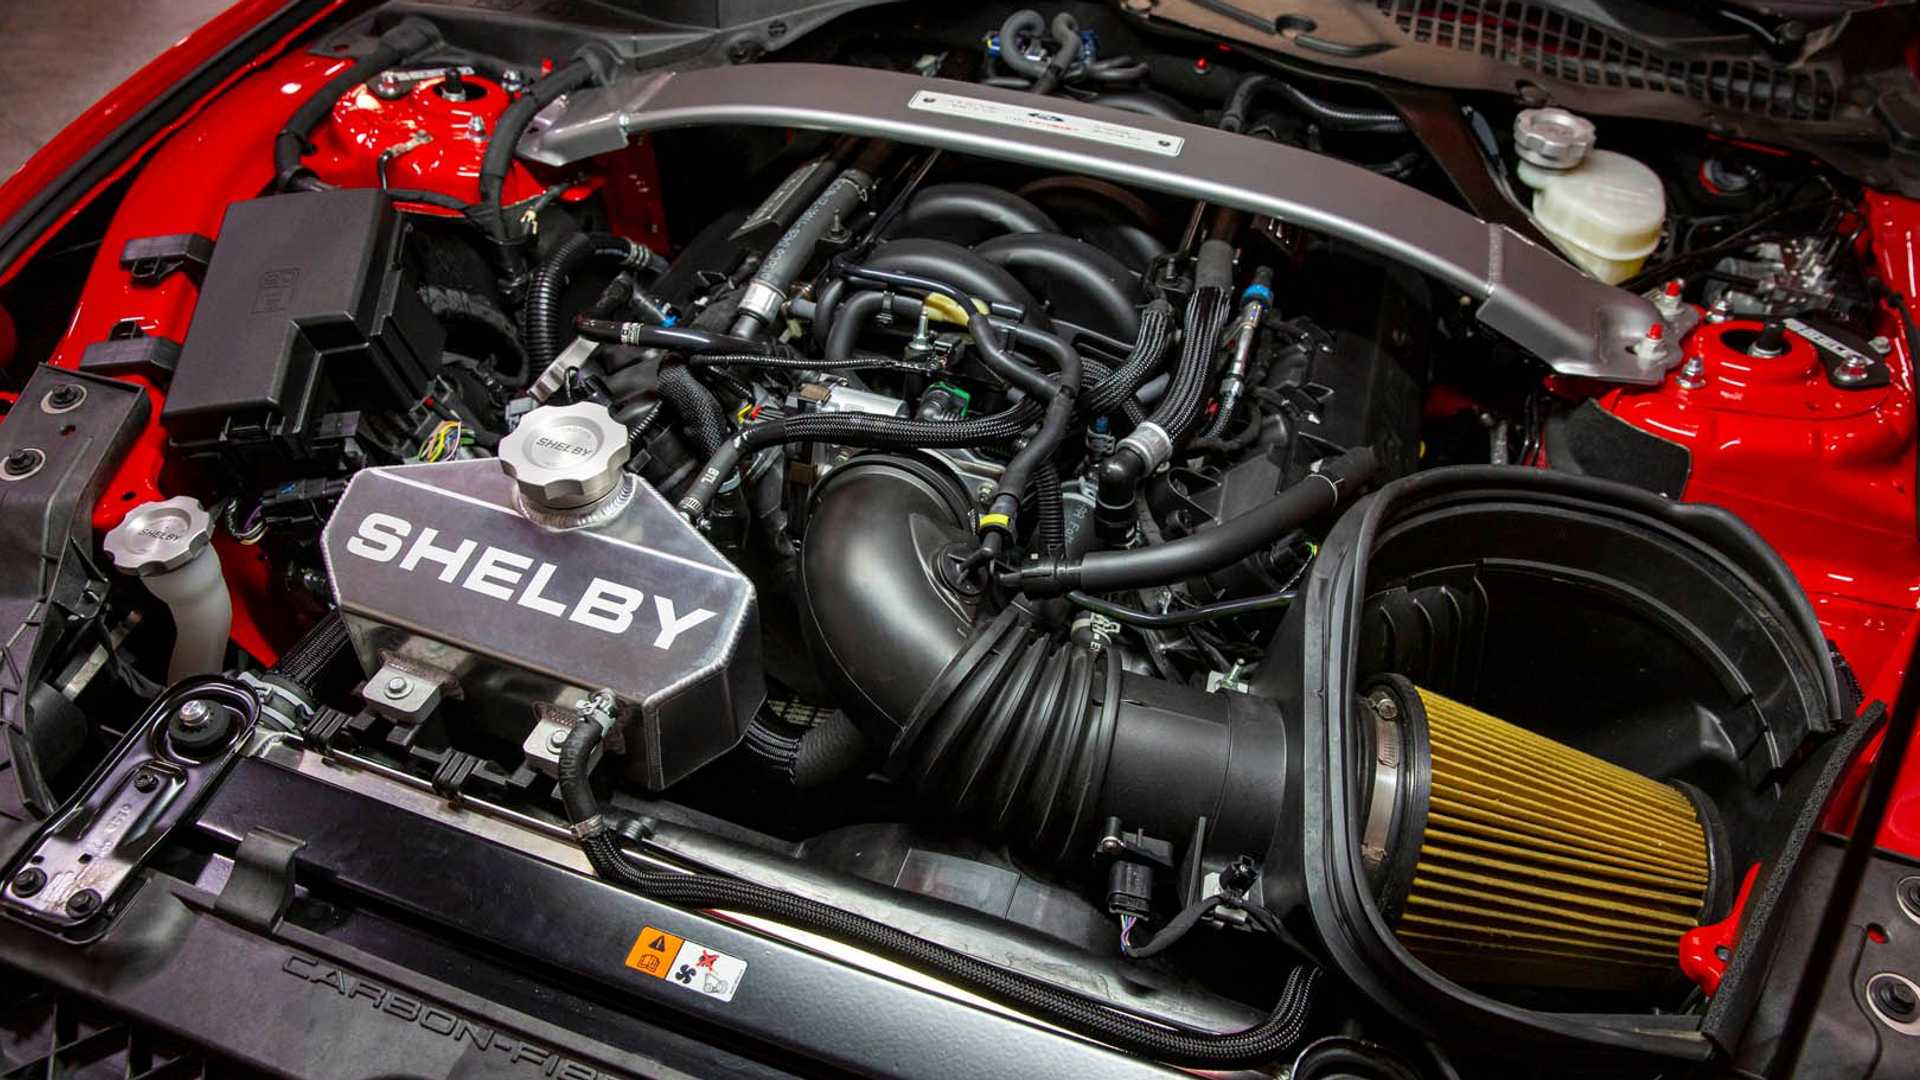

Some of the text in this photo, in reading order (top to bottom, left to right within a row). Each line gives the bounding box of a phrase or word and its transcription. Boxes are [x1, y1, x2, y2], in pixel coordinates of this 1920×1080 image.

[536, 437, 592, 457] SHELBY
[346, 512, 718, 650] SHELBY
[282, 955, 619, 1080] CARBON-FIB
